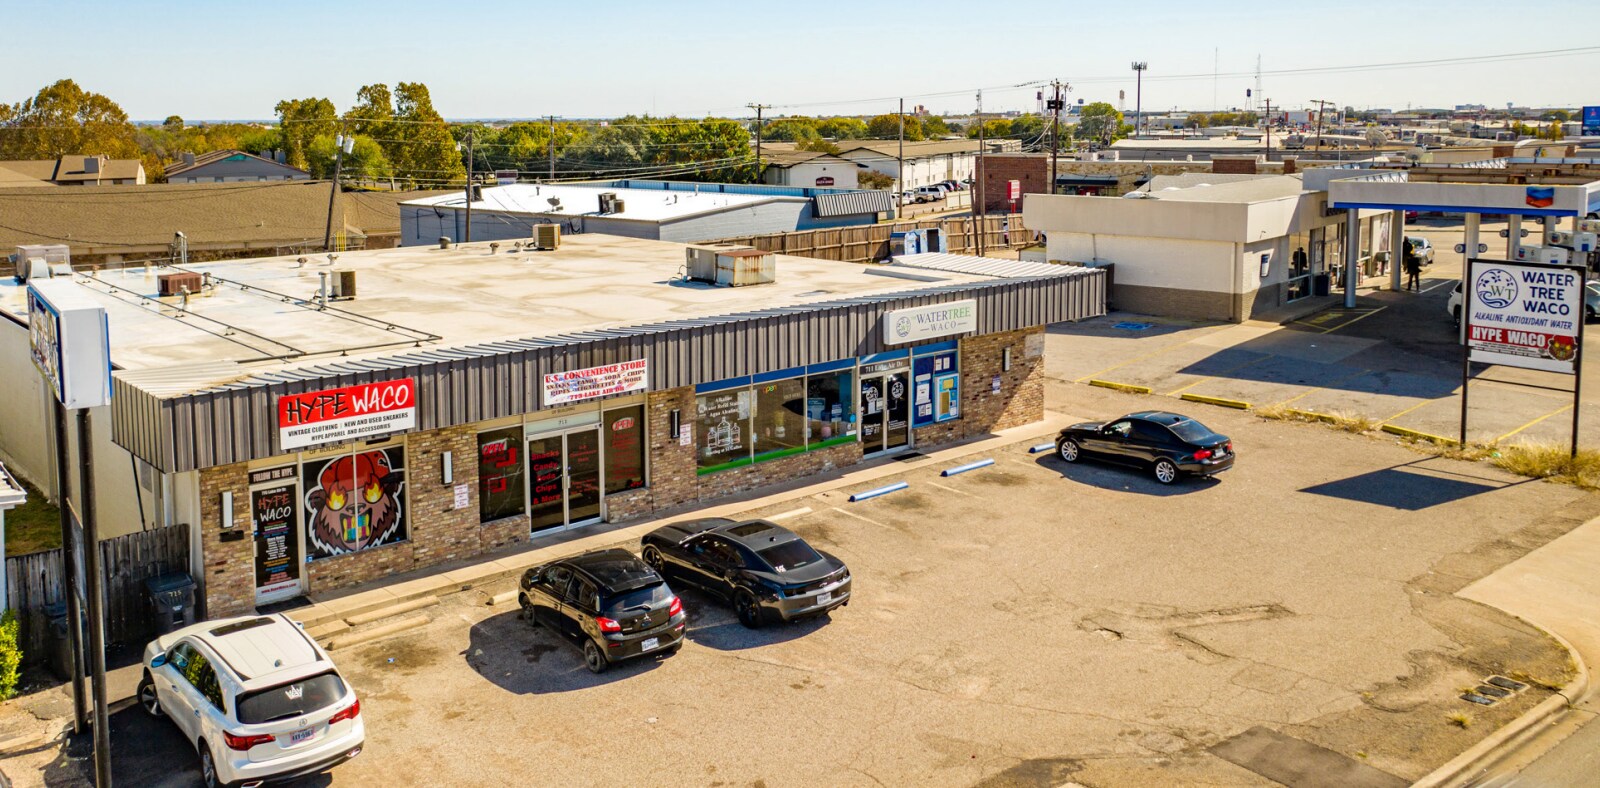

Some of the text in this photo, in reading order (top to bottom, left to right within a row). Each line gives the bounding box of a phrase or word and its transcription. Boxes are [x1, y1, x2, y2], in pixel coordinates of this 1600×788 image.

[1522, 271, 1574, 286] WATER
[1490, 286, 1514, 300] WT
[1530, 287, 1564, 300] TREE
[1523, 300, 1569, 315] WACO
[931, 321, 956, 331] WACO
[1475, 312, 1572, 330] ALKALINE ANTIOXIDANT WATER
[1472, 327, 1545, 347] HYPE WACO
[564, 365, 618, 380] CONVENIENCE
[621, 361, 645, 370] STORE
[546, 381, 570, 390] SNACKS
[577, 381, 615, 391] CIGARETTES
[763, 384, 777, 394] open
[286, 384, 409, 424] HYPE WACO
[288, 428, 311, 437] VINTAGE
[312, 424, 338, 433] CLOTHING
[368, 416, 382, 424] USED
[383, 412, 408, 422] SNEAKERS
[612, 418, 634, 431] OPEN
[312, 433, 324, 441] HYPE
[325, 429, 346, 438] APPAREL
[358, 423, 391, 434] ACCESSORIES
[482, 443, 505, 456] OPEN
[531, 450, 559, 460] Snacks
[534, 462, 558, 471] Candy
[253, 468, 292, 482] FOLLOW THE HYPE
[536, 473, 556, 481] Soda
[536, 484, 557, 493] Chips
[258, 493, 290, 510] HYPE
[542, 494, 560, 502] More
[260, 506, 292, 522] WACO
